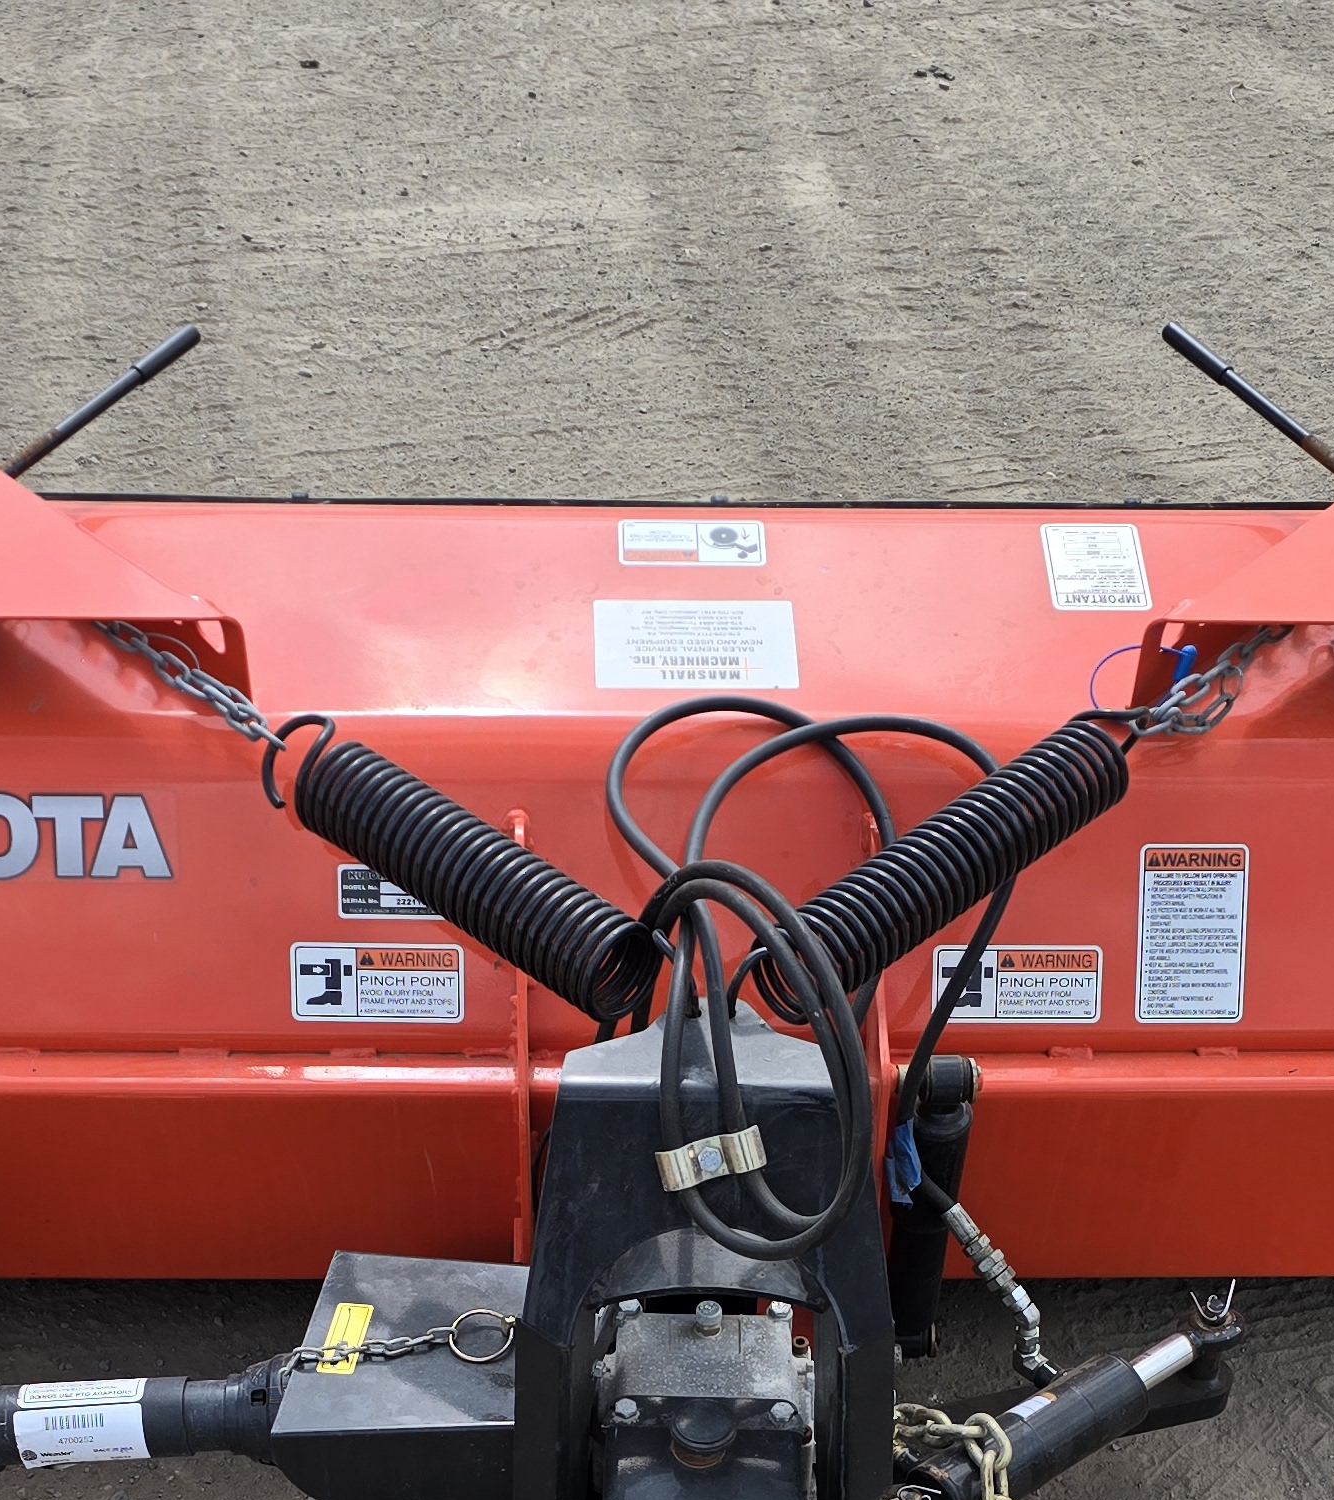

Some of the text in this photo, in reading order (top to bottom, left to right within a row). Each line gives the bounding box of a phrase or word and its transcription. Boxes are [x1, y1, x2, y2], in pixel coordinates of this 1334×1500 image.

[1064, 594, 1141, 604] IMPORTANT
[629, 655, 740, 666] MACHINERY, Inc.
[660, 670, 741, 680] MARSHALL
[1161, 852, 1241, 867] WARNING
[348, 871, 388, 881] KUBO
[380, 952, 453, 968] WARNING
[1020, 954, 1093, 968] WARNING
[360, 976, 455, 987] PINCH POINT
[1000, 977, 1093, 987] PINCH POINT
[384, 989, 410, 997] INJURY
[58, 1435, 94, 1445] 4700252
